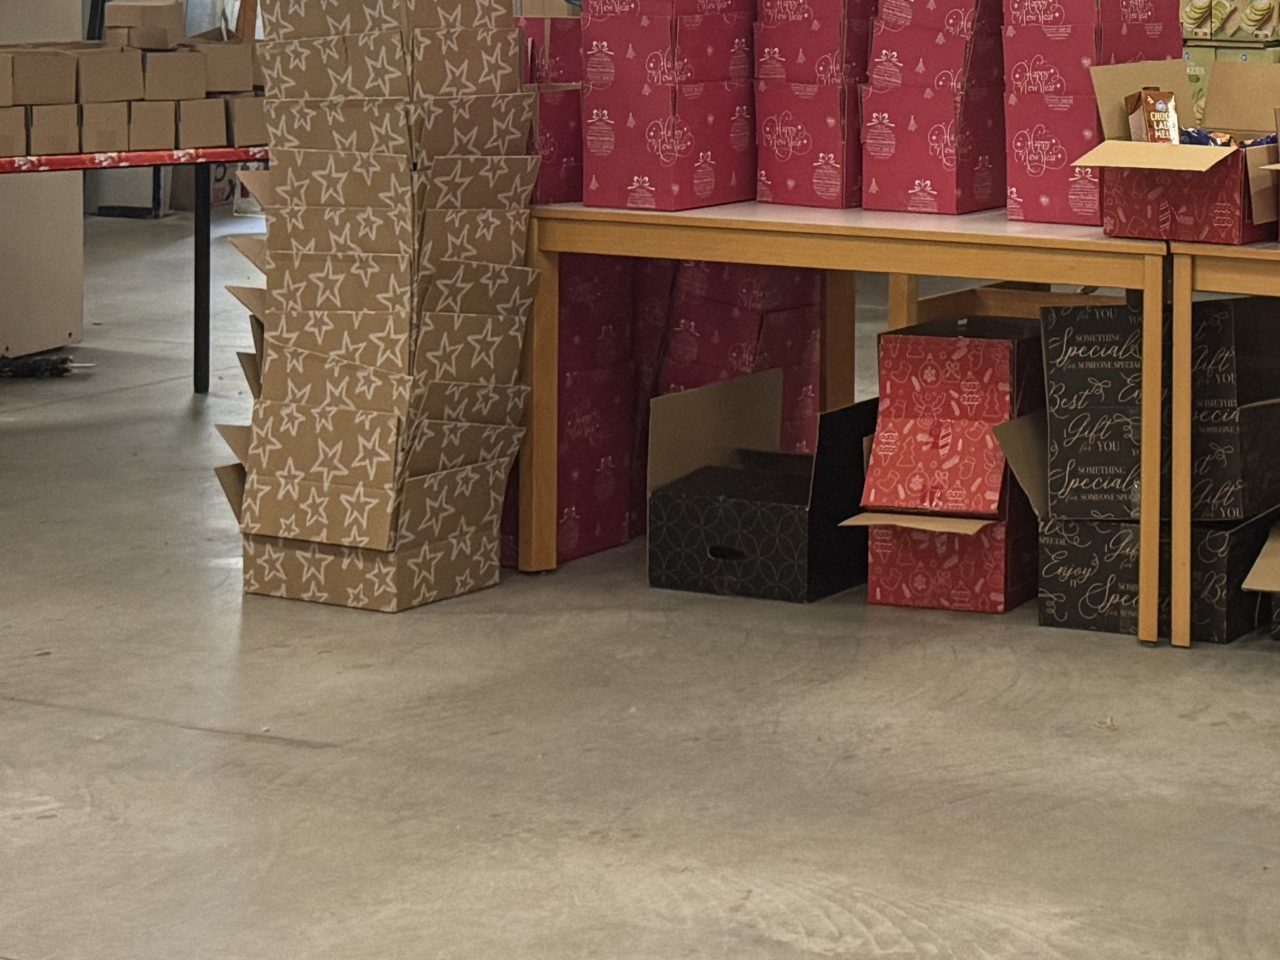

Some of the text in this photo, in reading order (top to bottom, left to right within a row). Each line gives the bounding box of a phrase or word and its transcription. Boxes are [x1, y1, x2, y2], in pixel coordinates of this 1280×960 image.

[1150, 111, 1171, 121] CHOC
[1153, 121, 1171, 131] LAD
[1155, 130, 1172, 140] MEL
[1056, 326, 1140, 368] Special
[1113, 360, 1141, 369] SPECIA
[1063, 412, 1113, 448] Gift
[1097, 441, 1120, 452] YOU
[1058, 458, 1140, 499] Special
[1042, 548, 1094, 584] Enjoy
